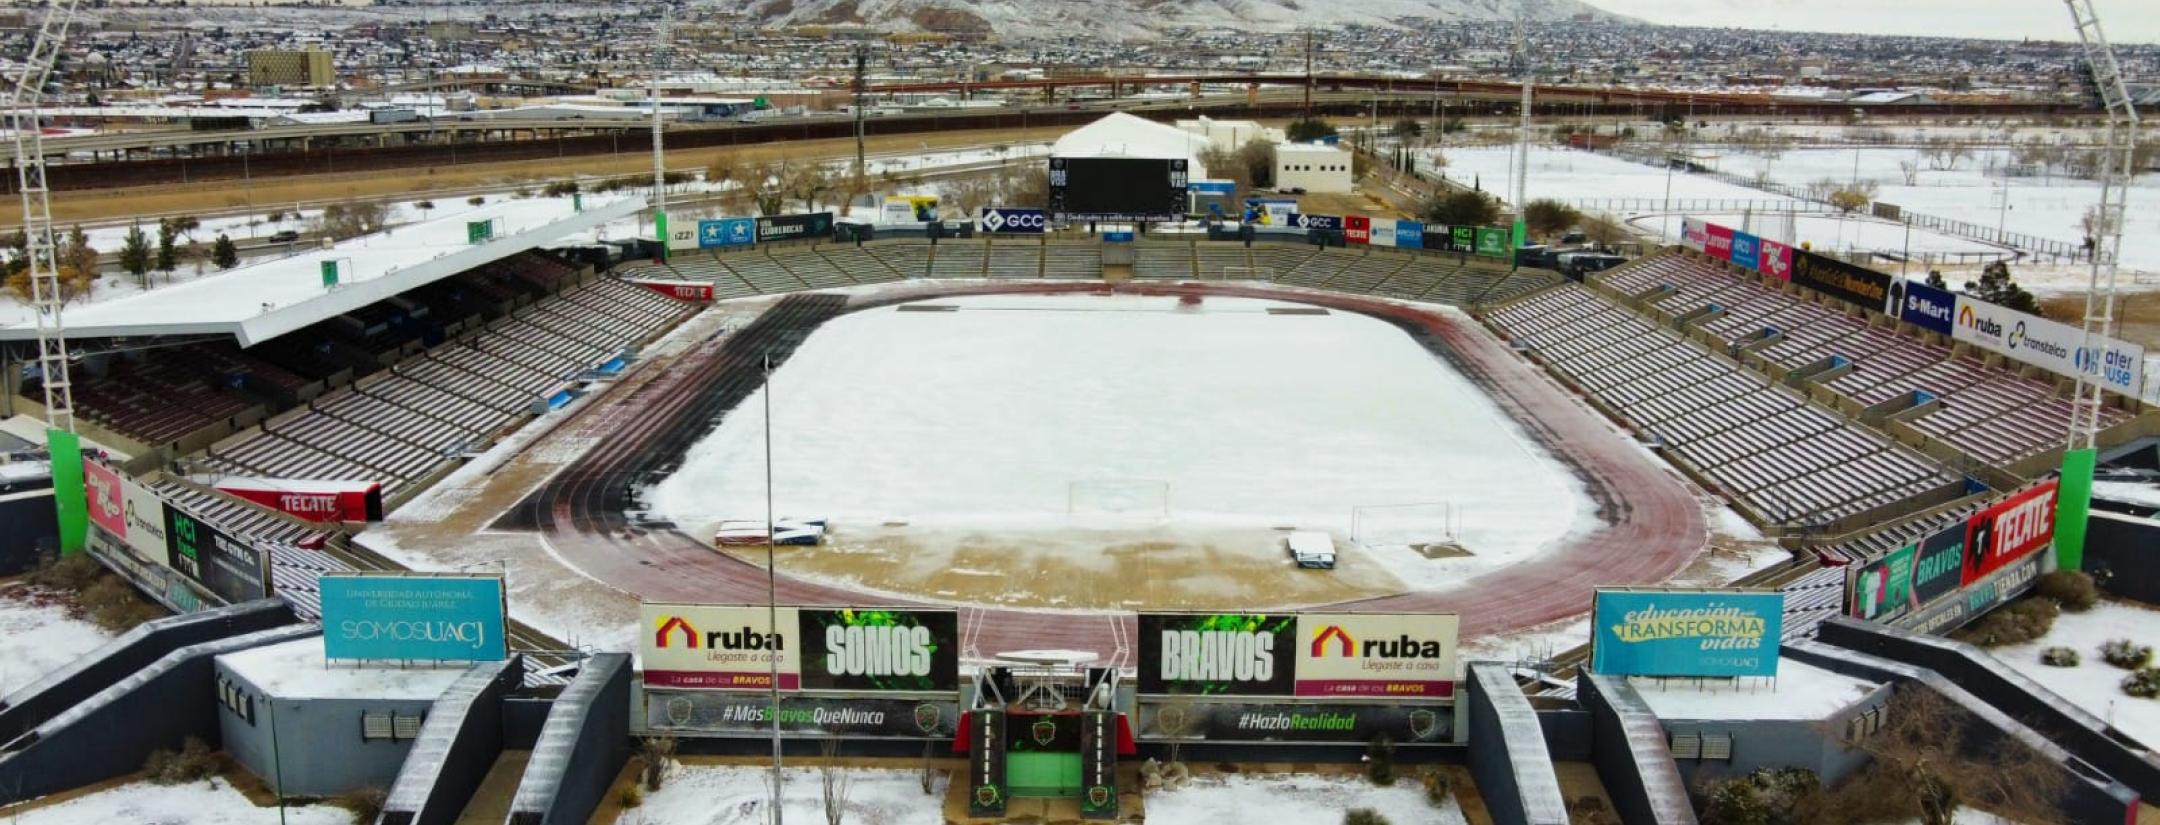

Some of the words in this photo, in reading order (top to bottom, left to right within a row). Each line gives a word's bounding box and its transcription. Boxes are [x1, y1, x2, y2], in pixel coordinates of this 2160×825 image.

[1006, 214, 1044, 228] GCC
[1310, 217, 1331, 229] GCC
[1763, 241, 1782, 257] Del
[1975, 316, 2002, 338] ruba
[2023, 328, 2067, 359] transtelco
[2105, 348, 2133, 371] ater
[280, 493, 337, 513] TECATE
[1994, 489, 2056, 558] TECATE
[1917, 542, 1962, 586] BRAVOS
[346, 589, 413, 600] UNIVERSIDAD
[365, 600, 379, 609] DE
[381, 600, 419, 609] CIUDAD
[1624, 603, 1738, 623] educación
[341, 620, 485, 649] SOMOSUACJ
[706, 626, 784, 650] ruba
[1620, 618, 1762, 639] TRANSFORMA
[825, 624, 932, 677] SOMOS
[1362, 634, 1440, 659] ruba
[1700, 636, 1760, 650] vidas
[706, 651, 748, 664] Llegaste
[751, 655, 758, 663] a
[1161, 630, 1274, 682] BRAVOS
[1361, 659, 1403, 672] Llegaste
[1406, 662, 1413, 670] a
[1416, 661, 1440, 671] casa
[683, 676, 703, 684] casa
[705, 676, 716, 684] de
[732, 676, 771, 686] BRAVOS
[1336, 685, 1356, 693] casa
[1358, 684, 1369, 693] de
[1386, 684, 1425, 694] BRAVOS
[1239, 713, 1356, 731] #HazloRealidad
